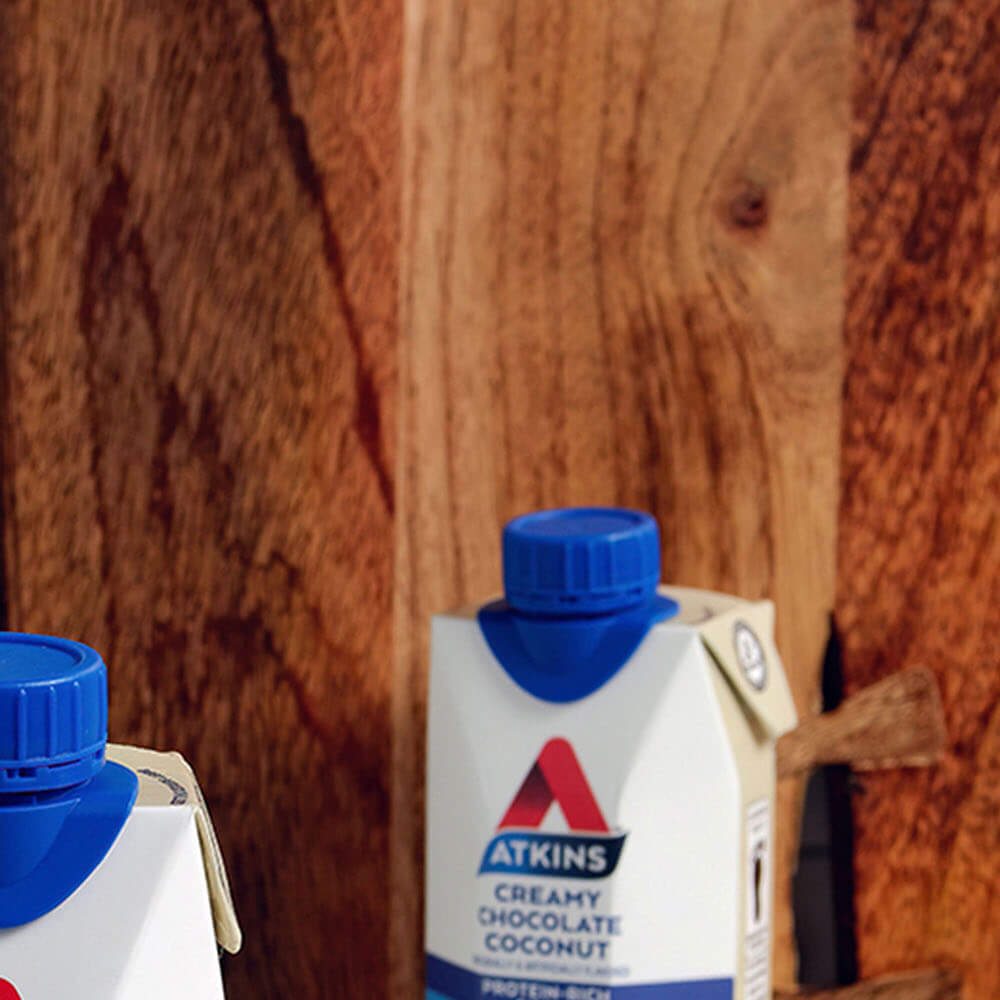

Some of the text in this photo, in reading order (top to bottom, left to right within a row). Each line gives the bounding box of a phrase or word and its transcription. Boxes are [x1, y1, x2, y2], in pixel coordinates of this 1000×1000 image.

[490, 839, 607, 873] ATKINS
[494, 883, 600, 908] CREAMY
[478, 906, 622, 935] CHOCOLATE
[484, 932, 610, 959] COCONUT
